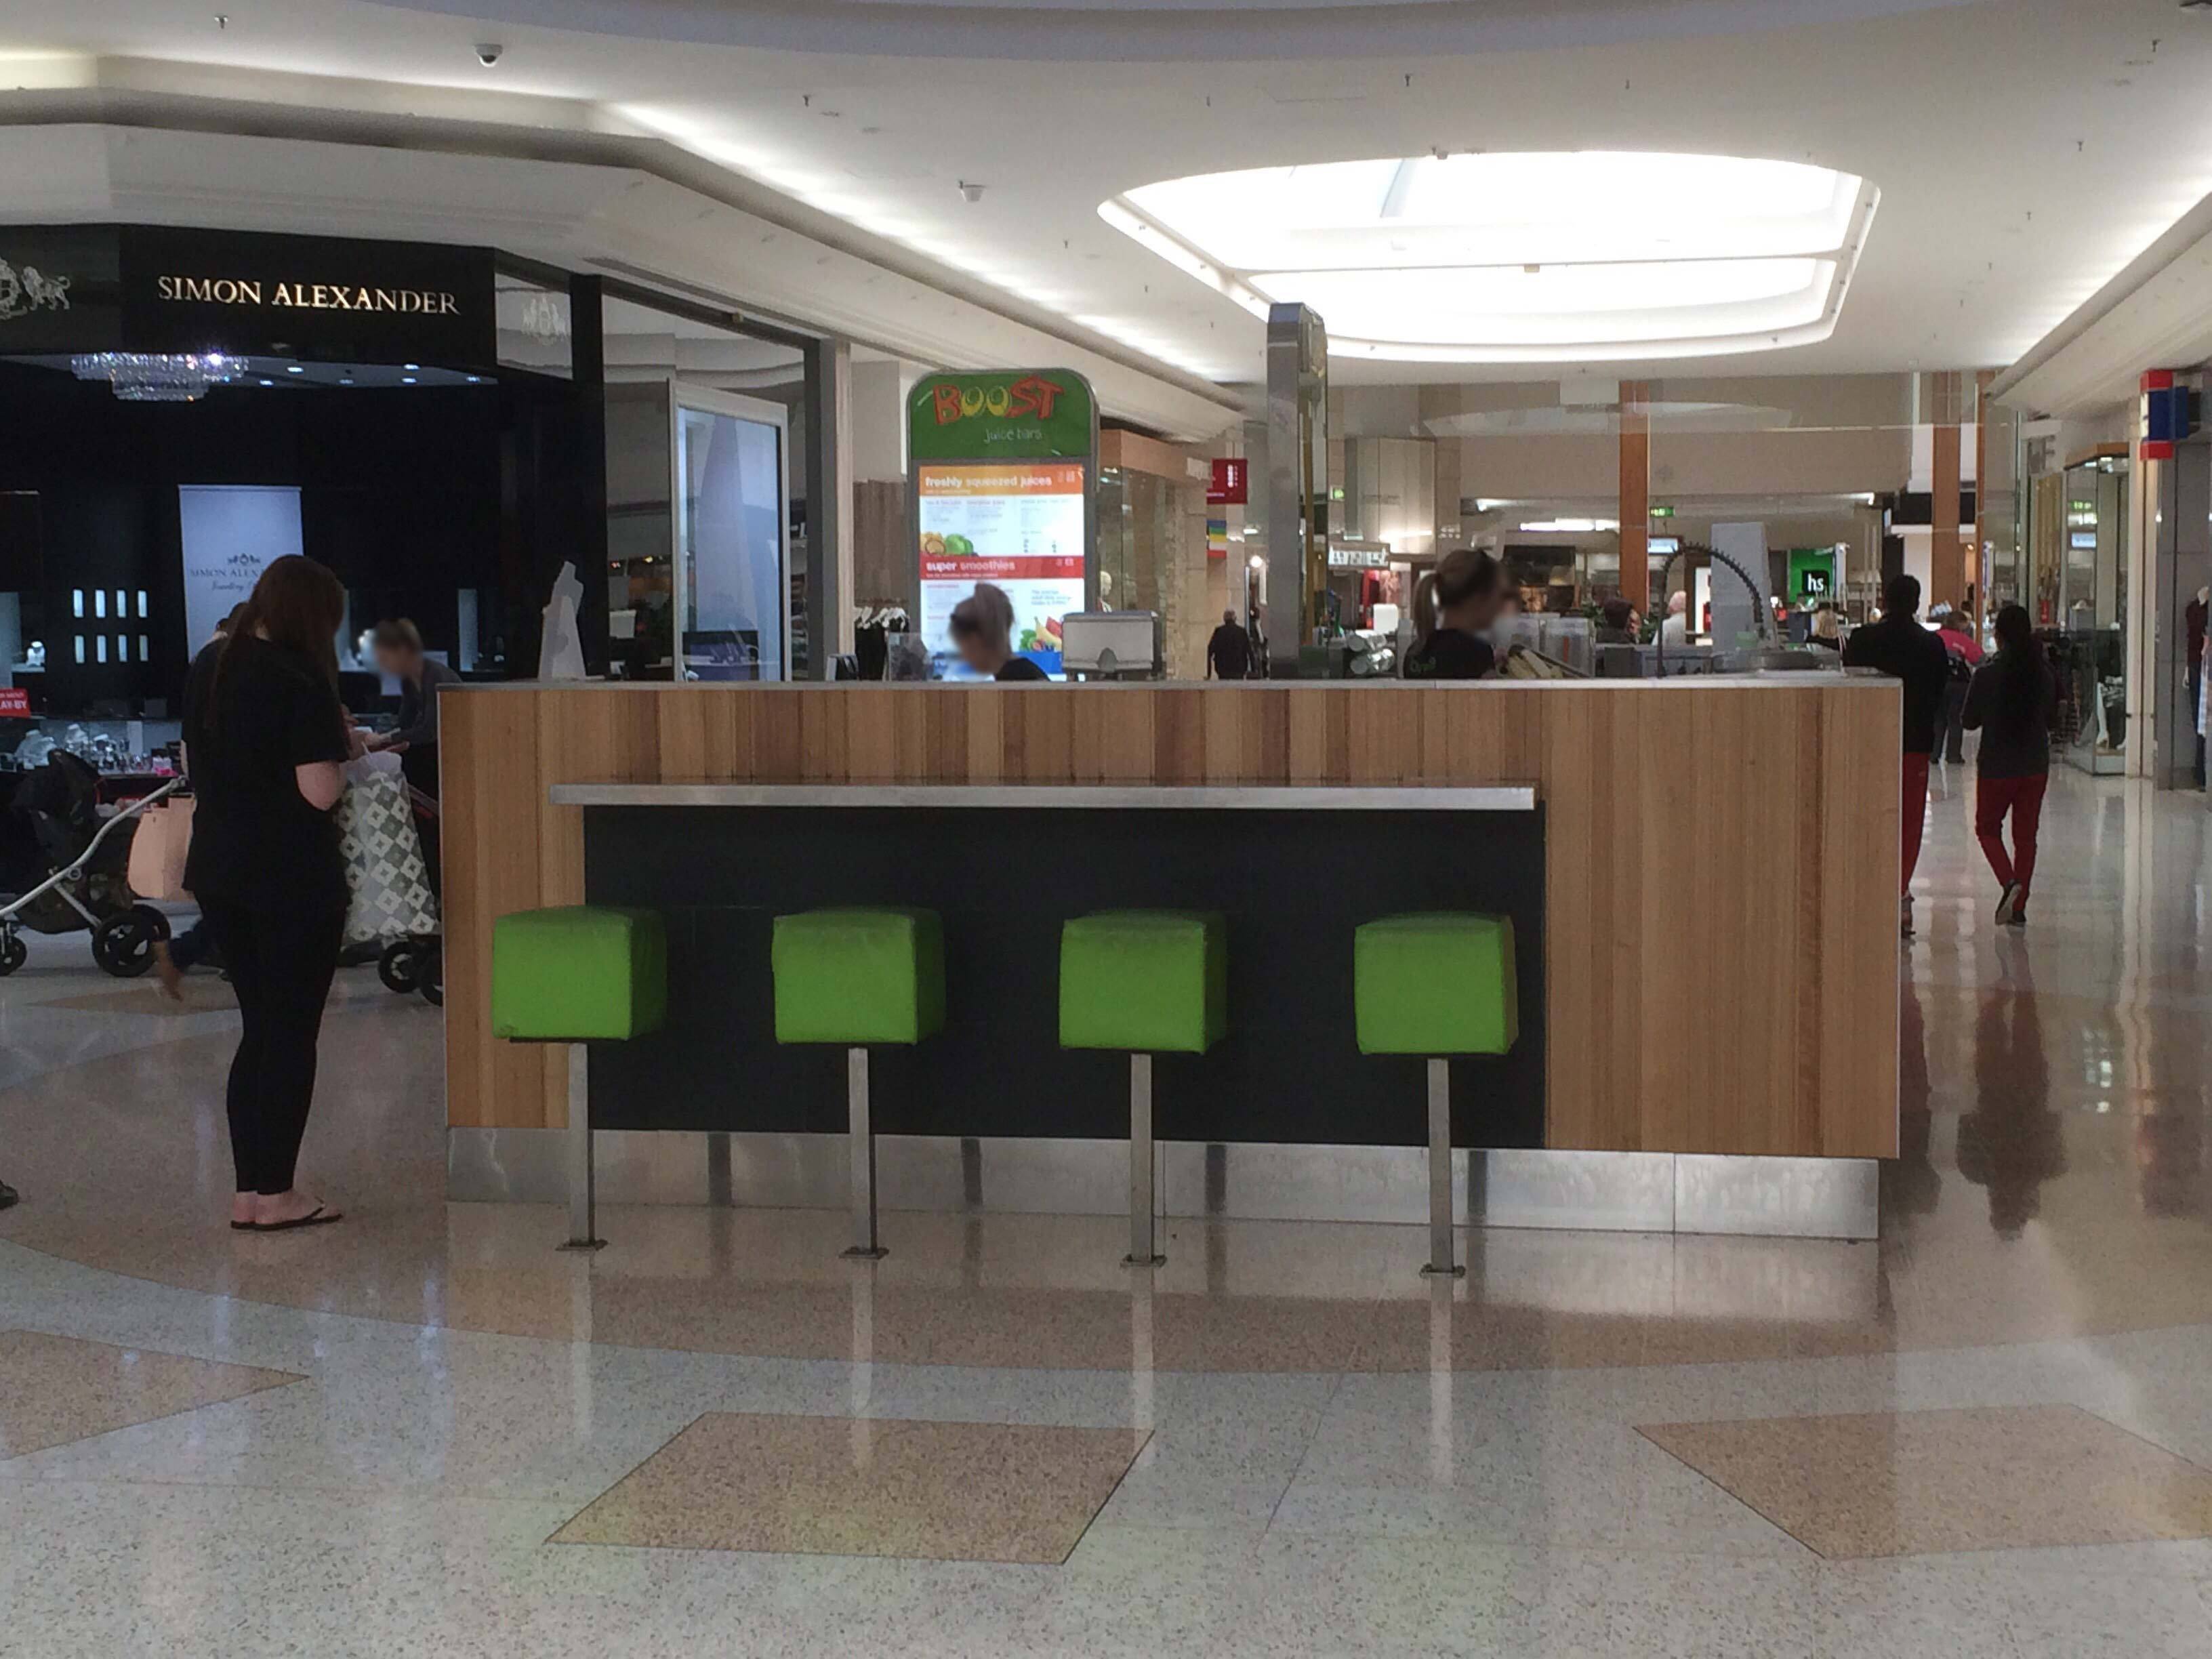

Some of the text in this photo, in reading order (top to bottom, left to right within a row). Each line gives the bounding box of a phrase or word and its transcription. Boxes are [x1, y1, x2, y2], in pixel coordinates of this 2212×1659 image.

[158, 275, 461, 314] SIMON ALEXANDER
[933, 375, 1065, 425] BOOST
[925, 475, 1052, 488] freshly squeezed juices
[926, 560, 1016, 572] super smoothies
[1807, 573, 1824, 592] hs
